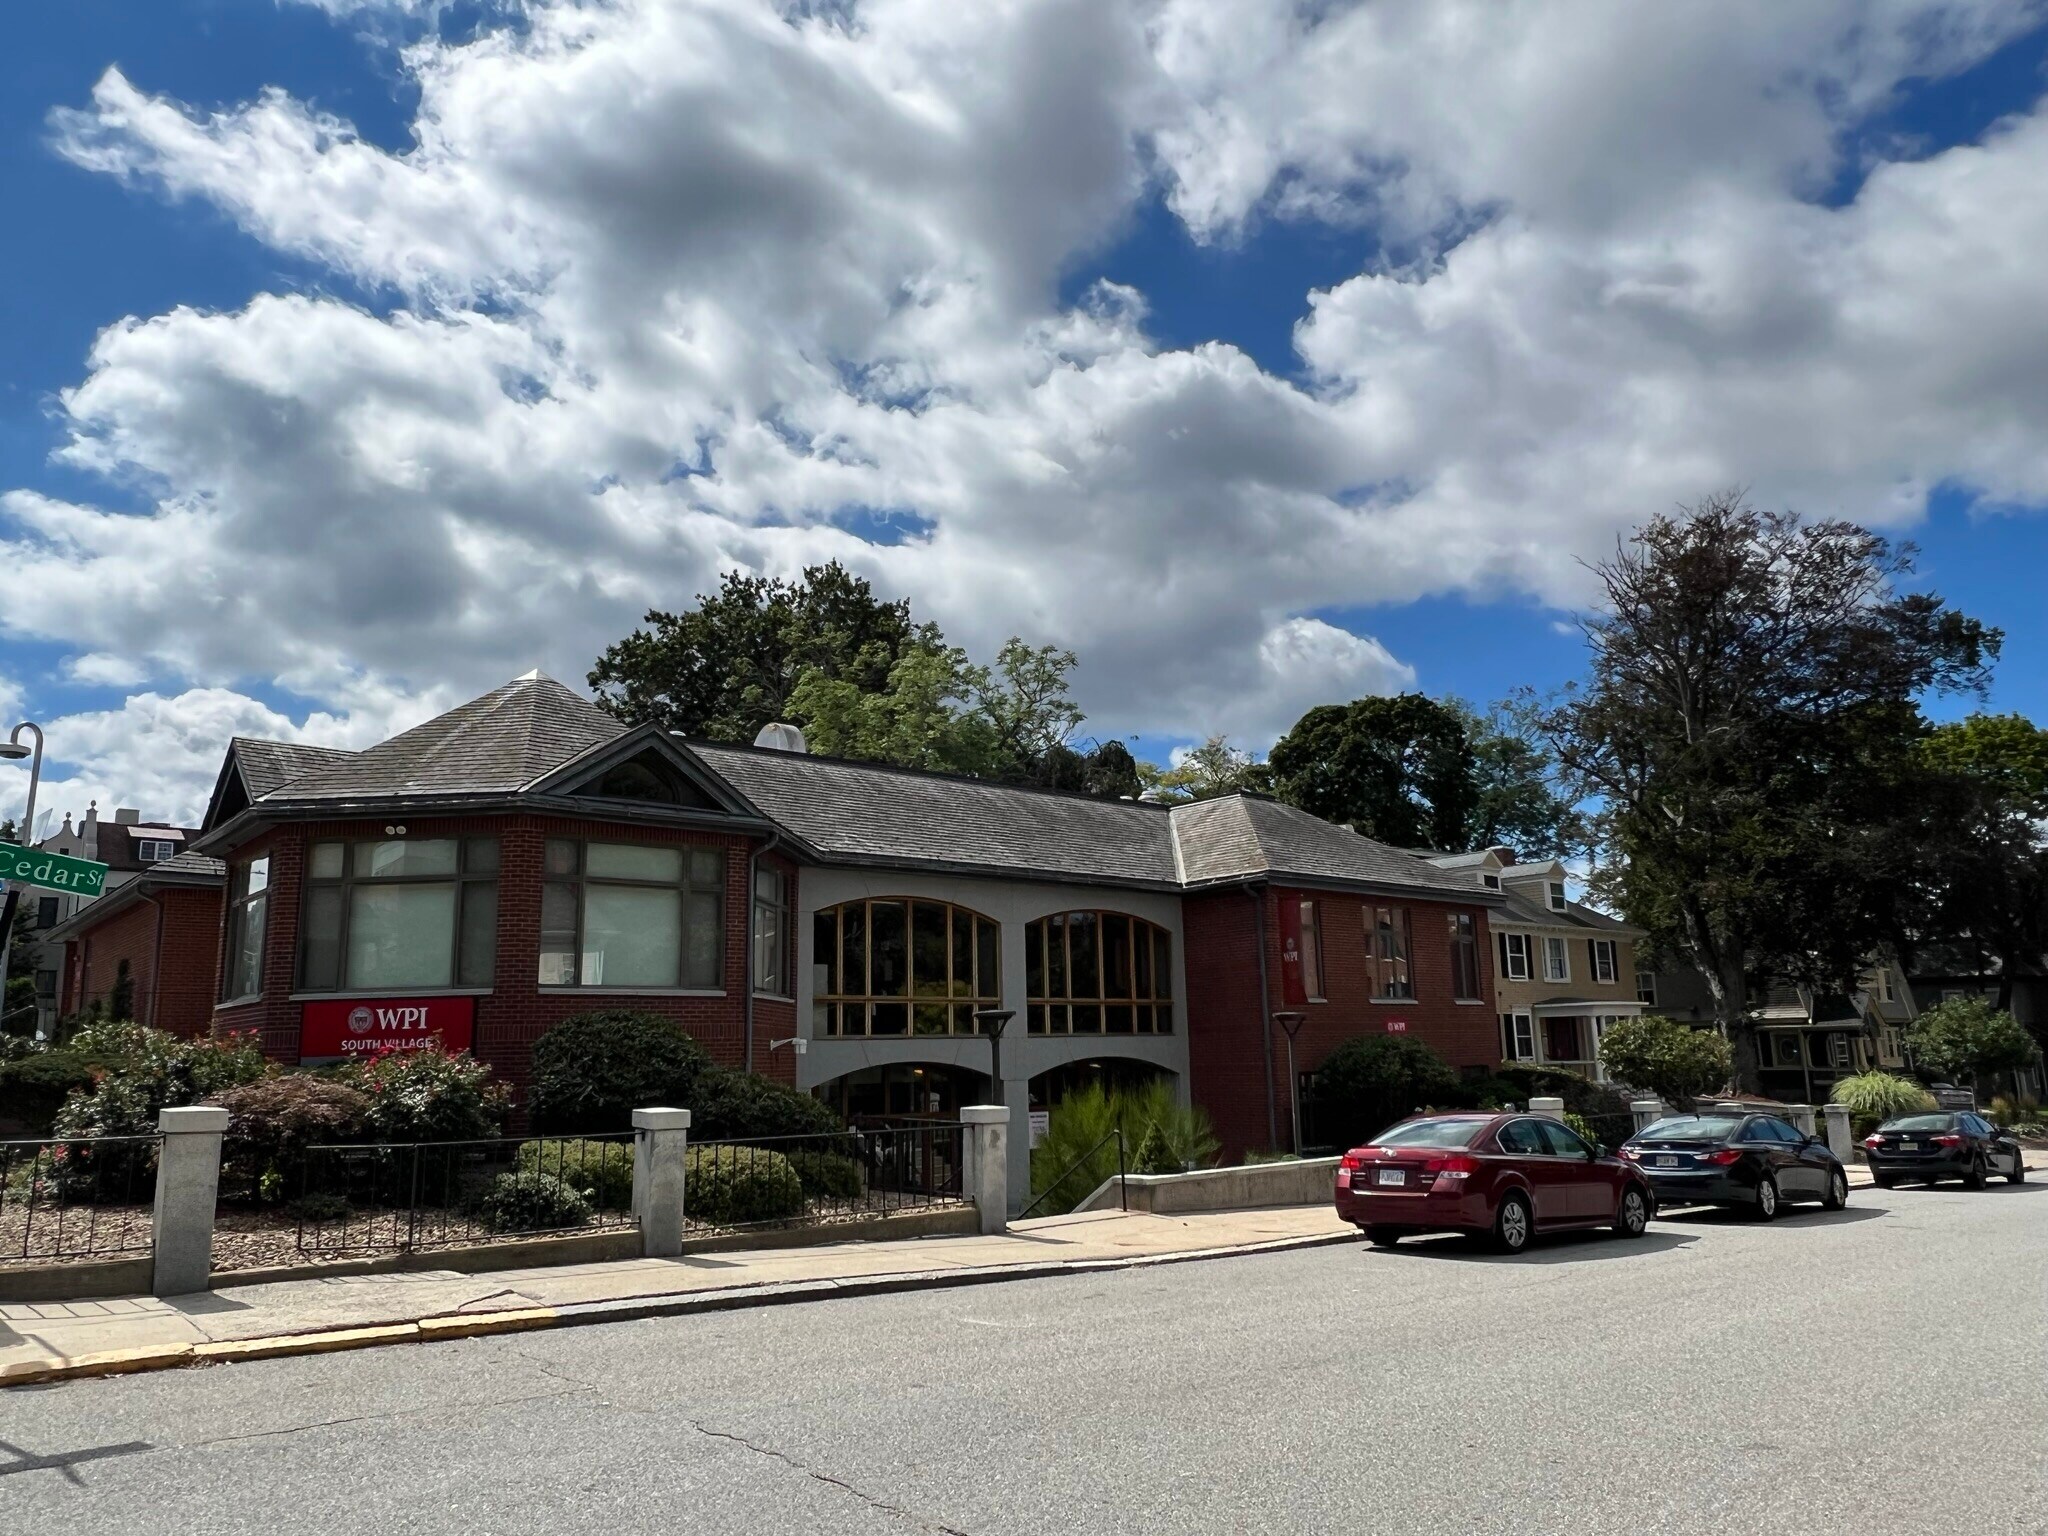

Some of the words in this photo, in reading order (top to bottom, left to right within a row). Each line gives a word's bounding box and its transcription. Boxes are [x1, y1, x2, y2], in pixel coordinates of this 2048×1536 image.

[0, 850, 85, 887] Cedar
[86, 869, 104, 887] St
[376, 1007, 428, 1030] WPI
[341, 1039, 381, 1051] SOUTH
